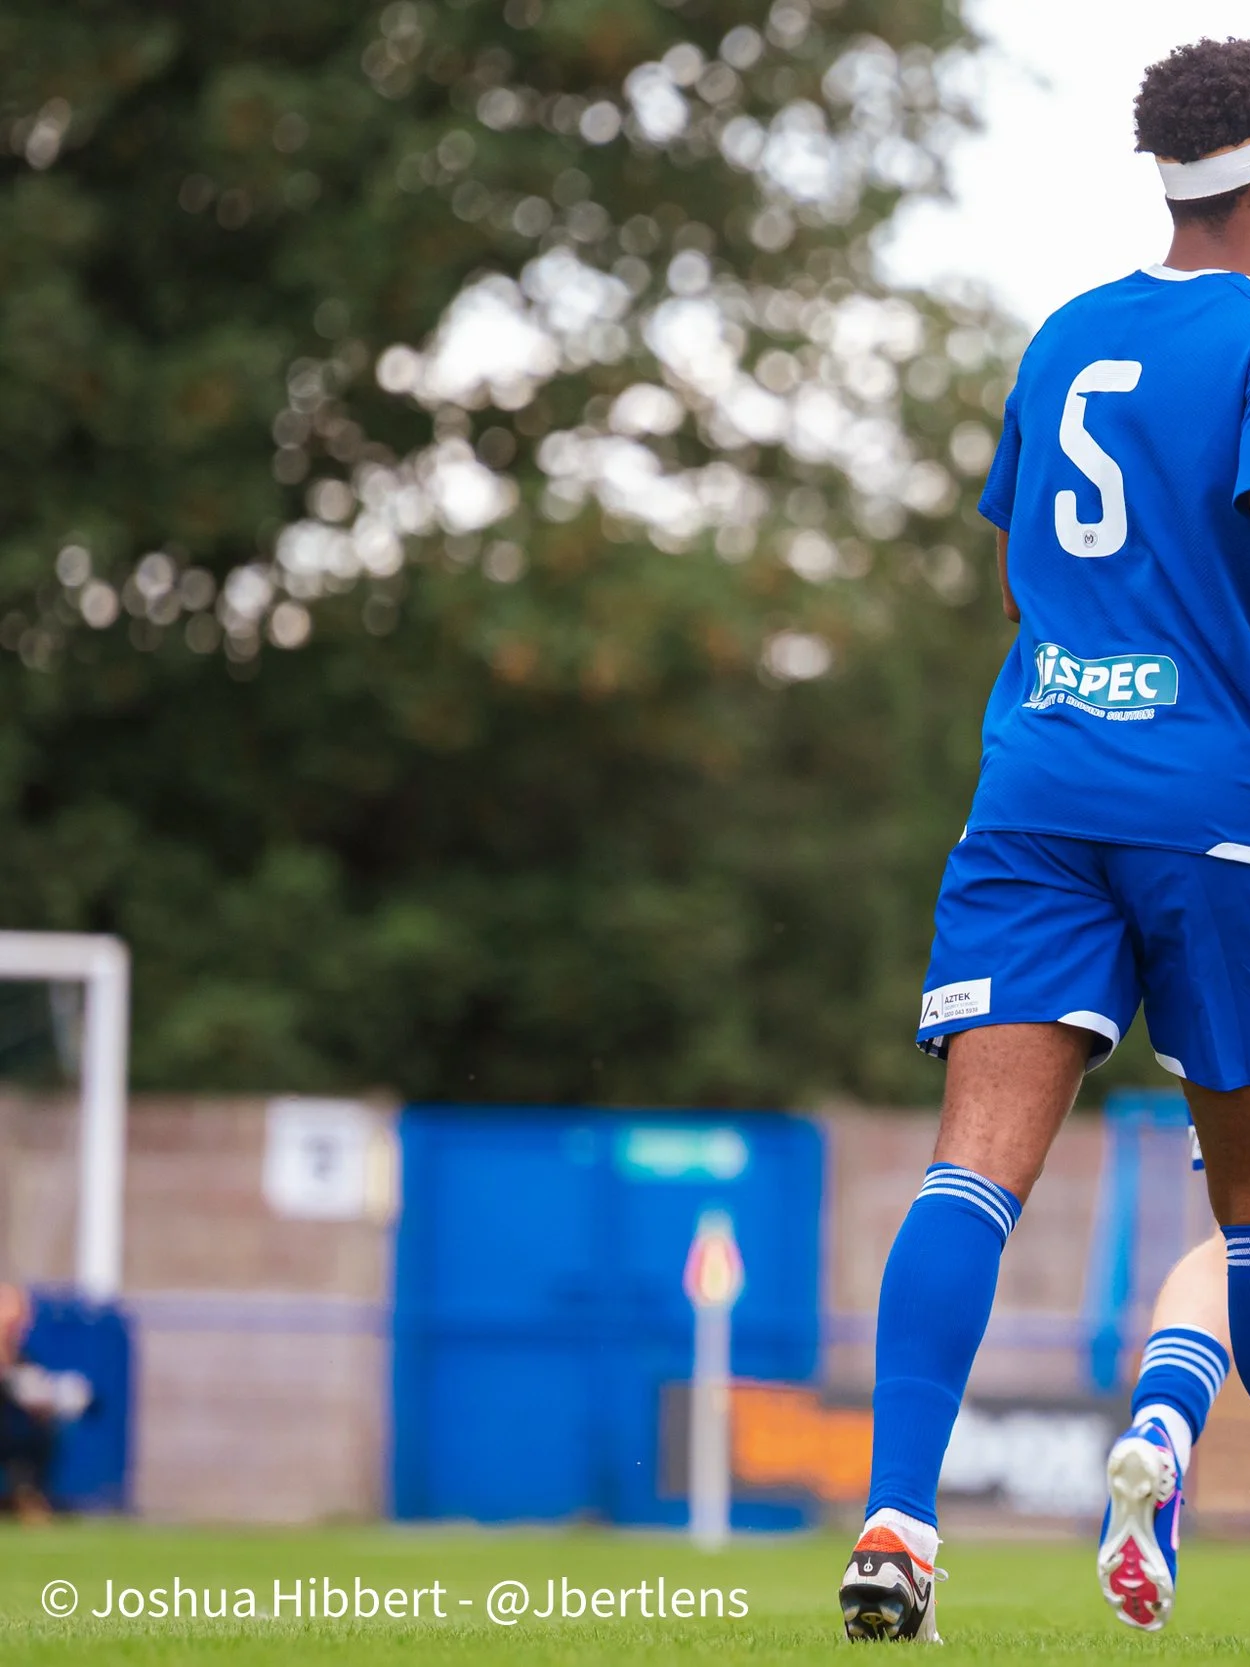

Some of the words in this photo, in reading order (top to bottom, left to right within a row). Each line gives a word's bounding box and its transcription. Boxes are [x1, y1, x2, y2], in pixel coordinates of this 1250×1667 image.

[1055, 359, 1143, 558] 5
[1106, 708, 1156, 722] SOLUTIONS
[945, 992, 971, 1004] AZTEK
